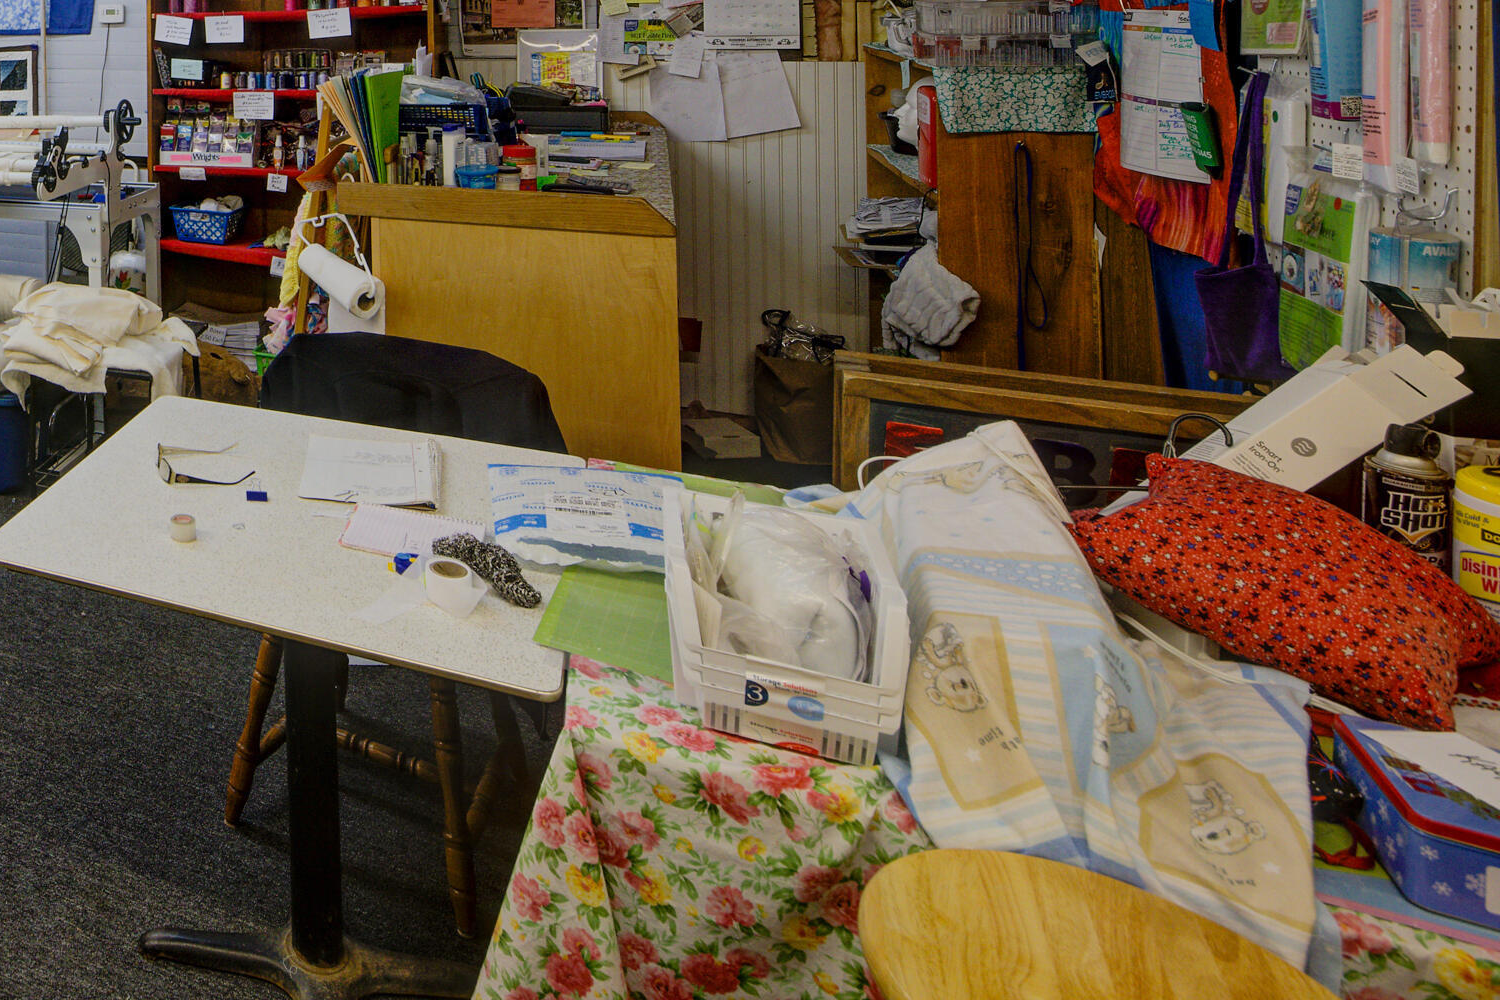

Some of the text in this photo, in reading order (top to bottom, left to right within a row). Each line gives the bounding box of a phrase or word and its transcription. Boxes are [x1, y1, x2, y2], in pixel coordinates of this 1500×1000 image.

[192, 153, 220, 163] Wrights
[1256, 440, 1283, 464] Smart
[1388, 490, 1445, 513] HOT
[1380, 507, 1448, 535] SHOT
[1465, 512, 1481, 522] Cold
[1481, 577, 1500, 595] W
[746, 684, 764, 702] 3
[752, 674, 782, 687] Storage
[782, 681, 818, 695] Solutions
